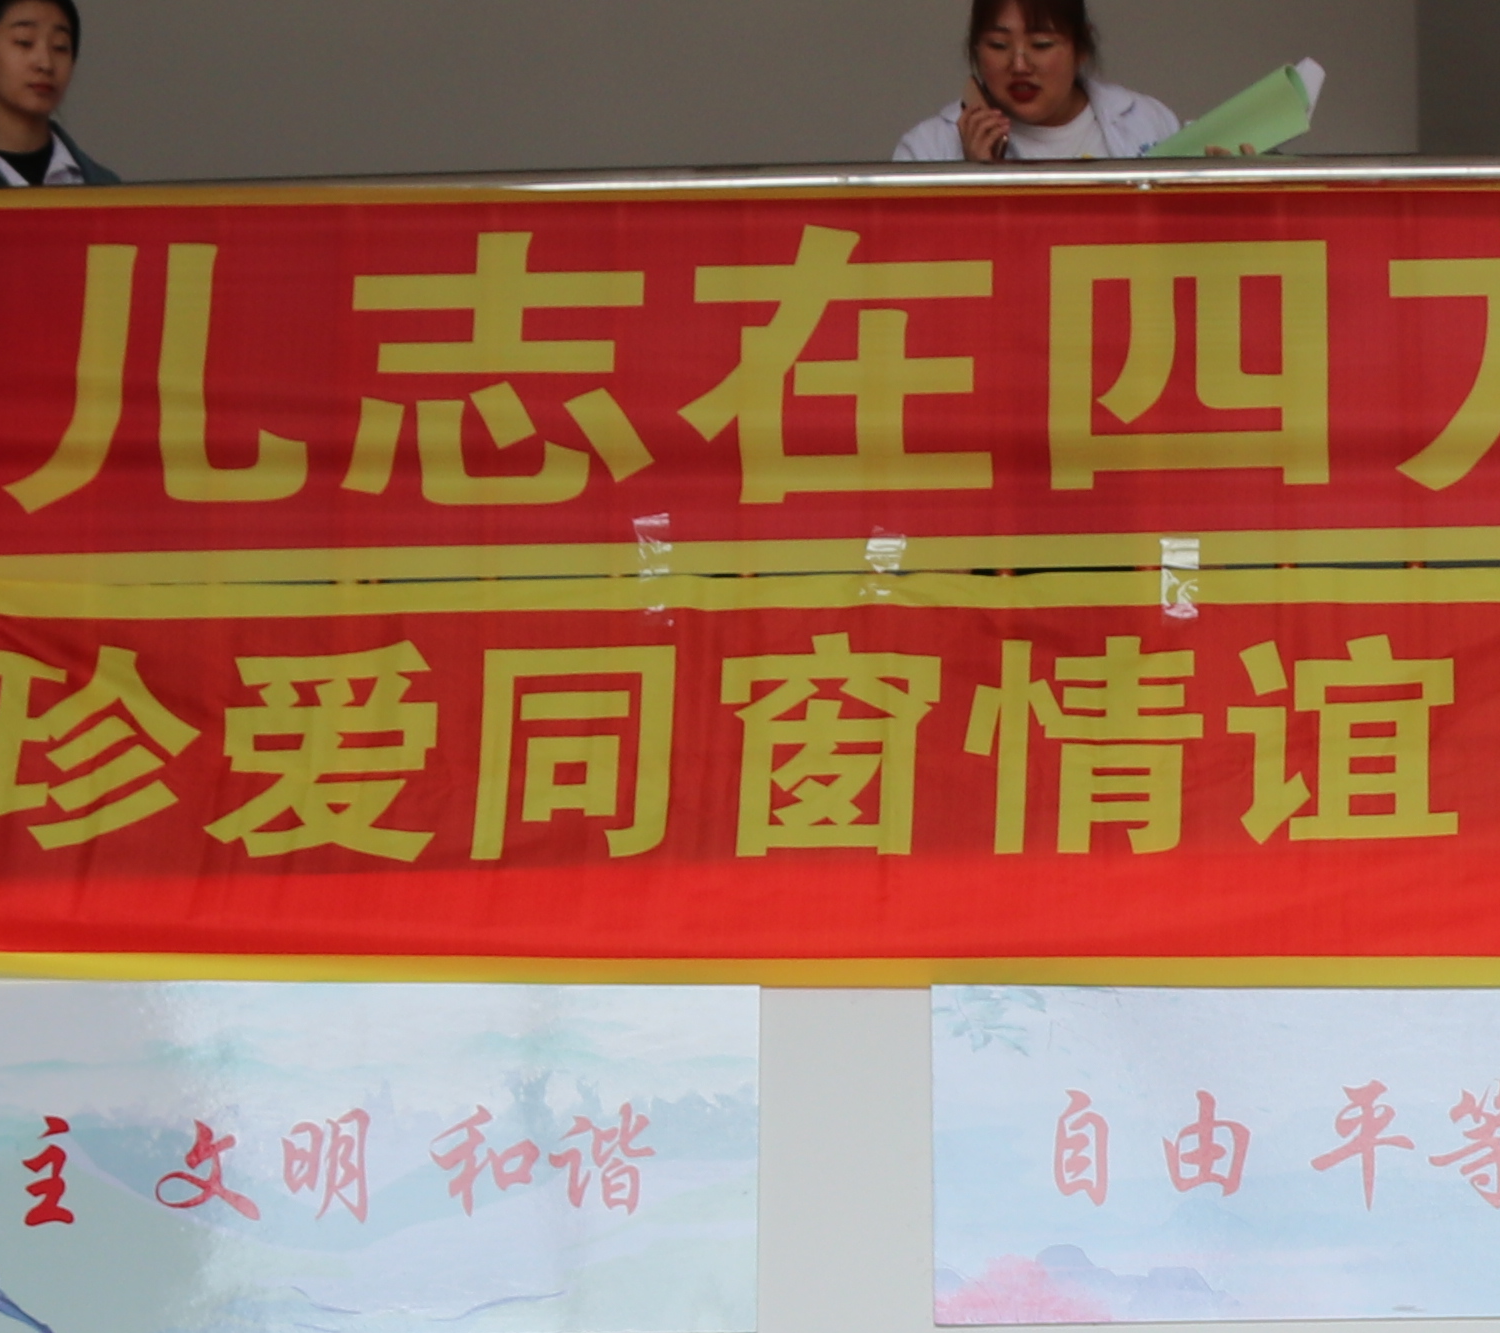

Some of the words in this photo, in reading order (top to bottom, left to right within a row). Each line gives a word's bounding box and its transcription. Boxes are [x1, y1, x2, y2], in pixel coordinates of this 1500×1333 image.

[152, 1108, 372, 1220] 文明
[435, 1104, 656, 1212] 和谐
[1053, 1088, 1254, 1205] 自由
